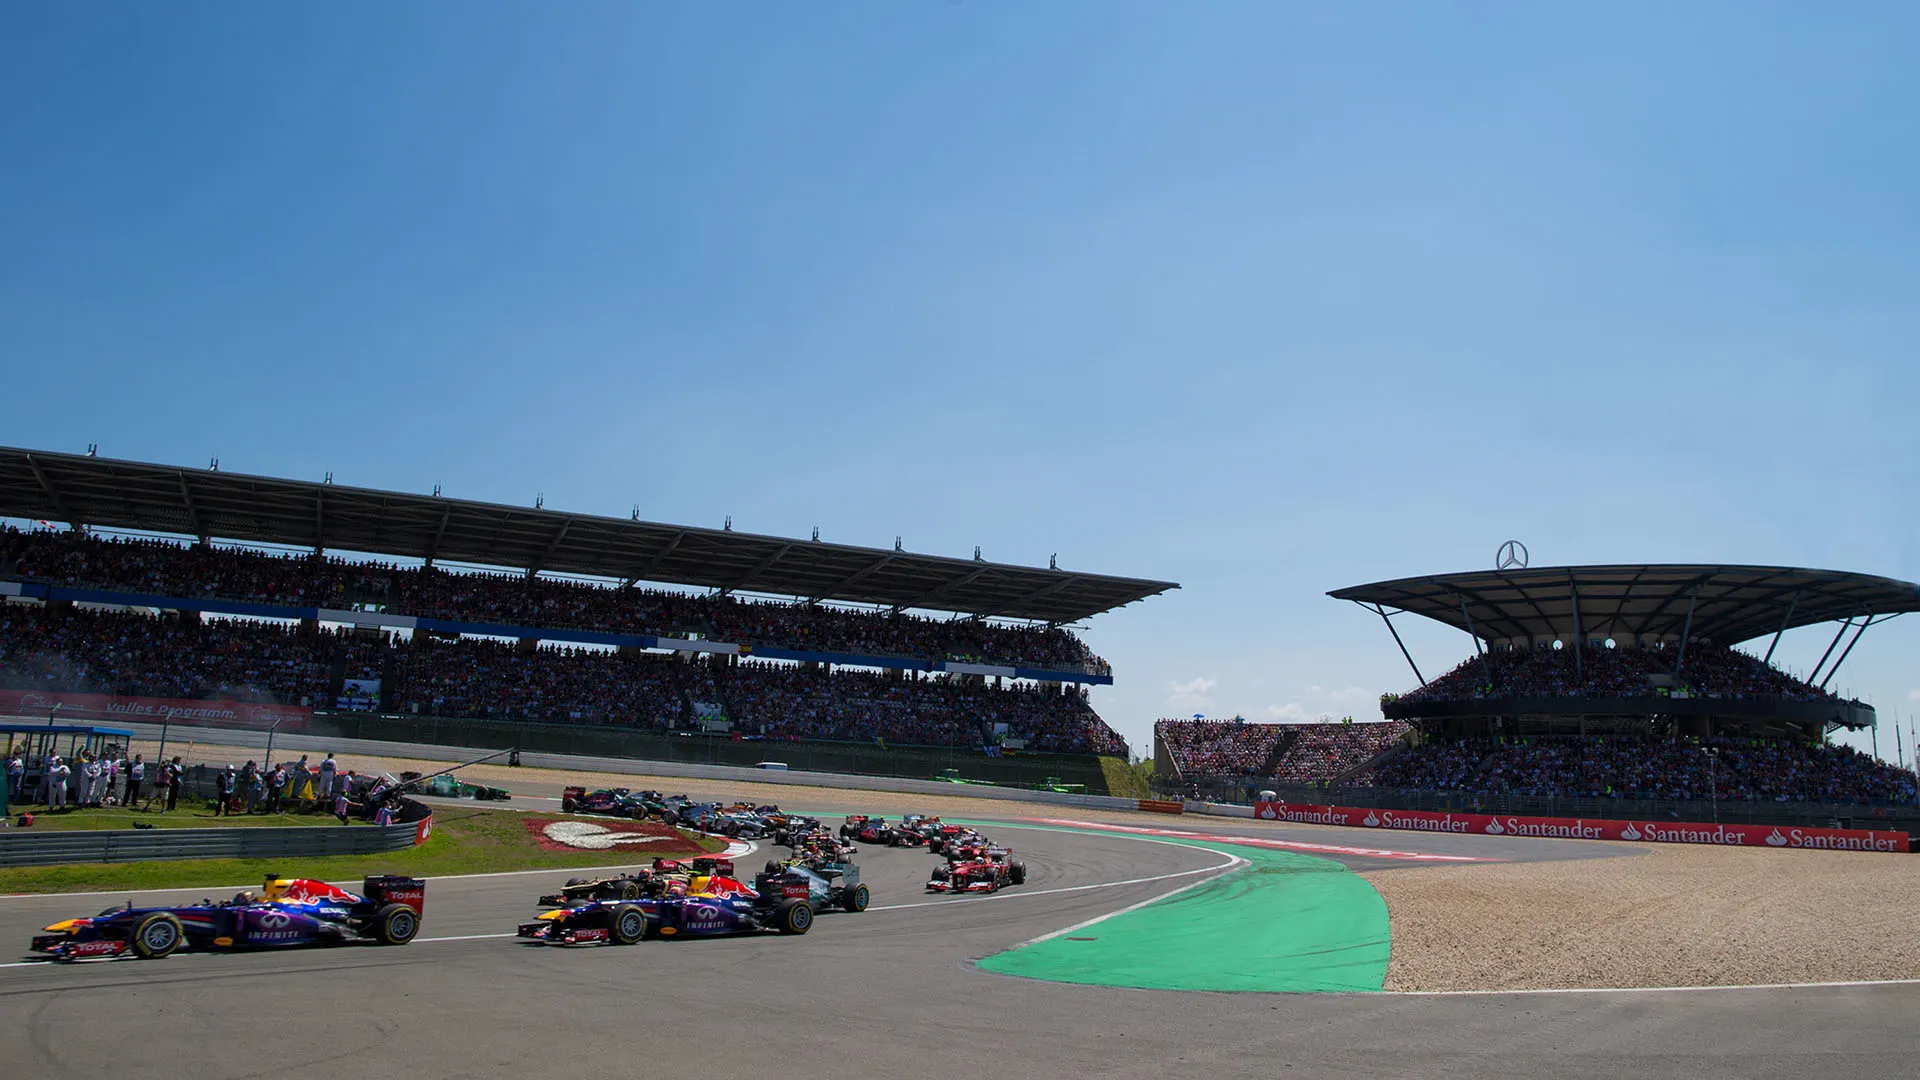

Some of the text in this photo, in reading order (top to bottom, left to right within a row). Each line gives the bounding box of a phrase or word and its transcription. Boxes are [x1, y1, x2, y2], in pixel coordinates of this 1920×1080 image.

[106, 701, 153, 714] Volles
[1278, 805, 1348, 825] Santander
[1383, 811, 1469, 832] Santander
[1507, 817, 1602, 839] Santander
[1644, 824, 1746, 845] Santander
[1790, 829, 1898, 851] Santander
[391, 890, 423, 899] TOTAL
[785, 886, 809, 894] TOTAL
[686, 920, 725, 929] INFINITI
[248, 930, 299, 939] INFINITI
[575, 930, 604, 938] TOTAL
[77, 942, 118, 952] TOTAL
